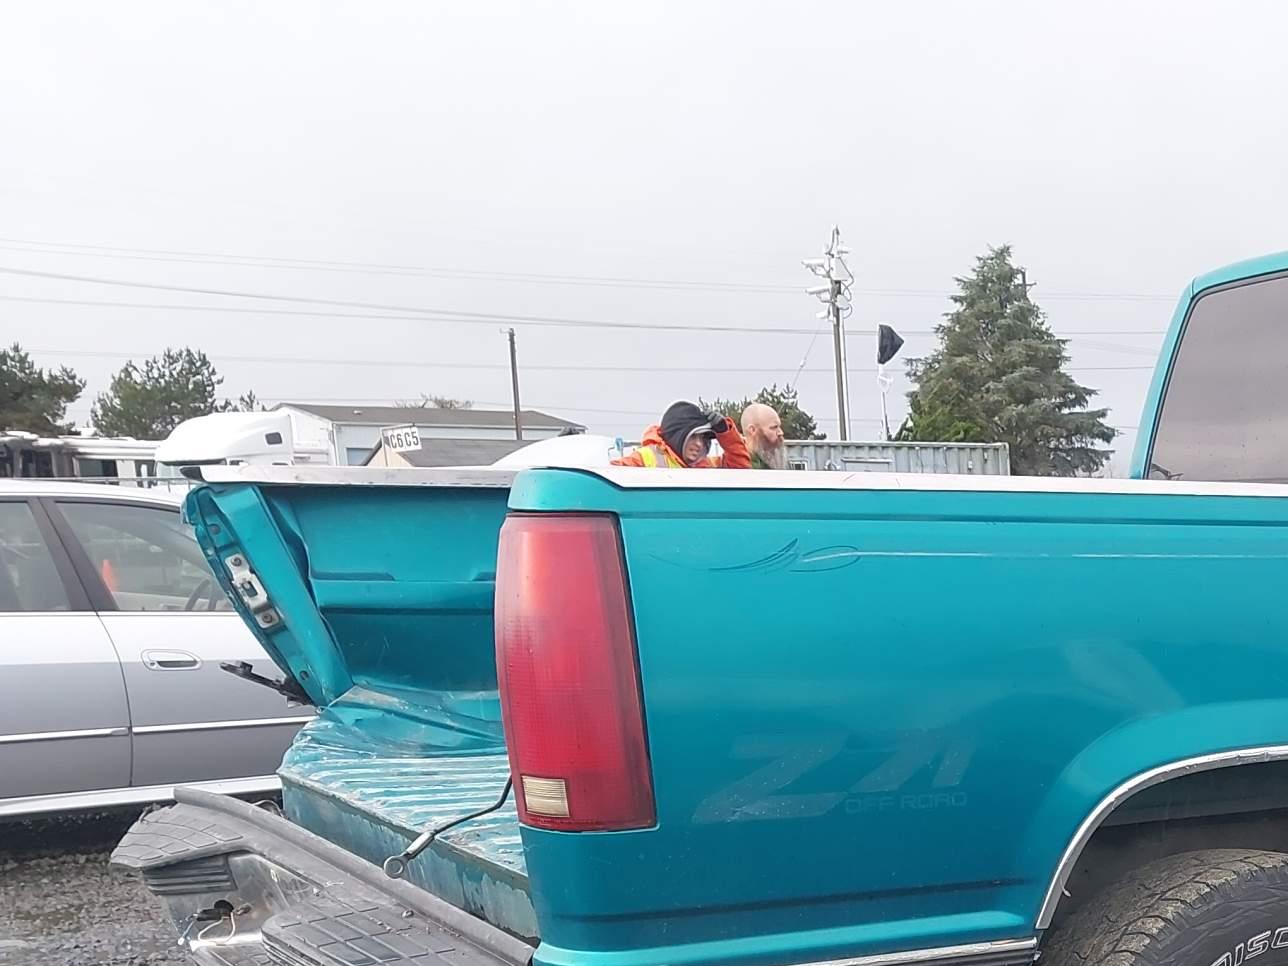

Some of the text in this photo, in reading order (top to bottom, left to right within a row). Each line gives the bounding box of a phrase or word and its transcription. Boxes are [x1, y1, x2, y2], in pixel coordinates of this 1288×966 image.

[389, 431, 419, 449] C6C5
[691, 727, 977, 825] Z71
[843, 791, 968, 814] OFF ROAD
